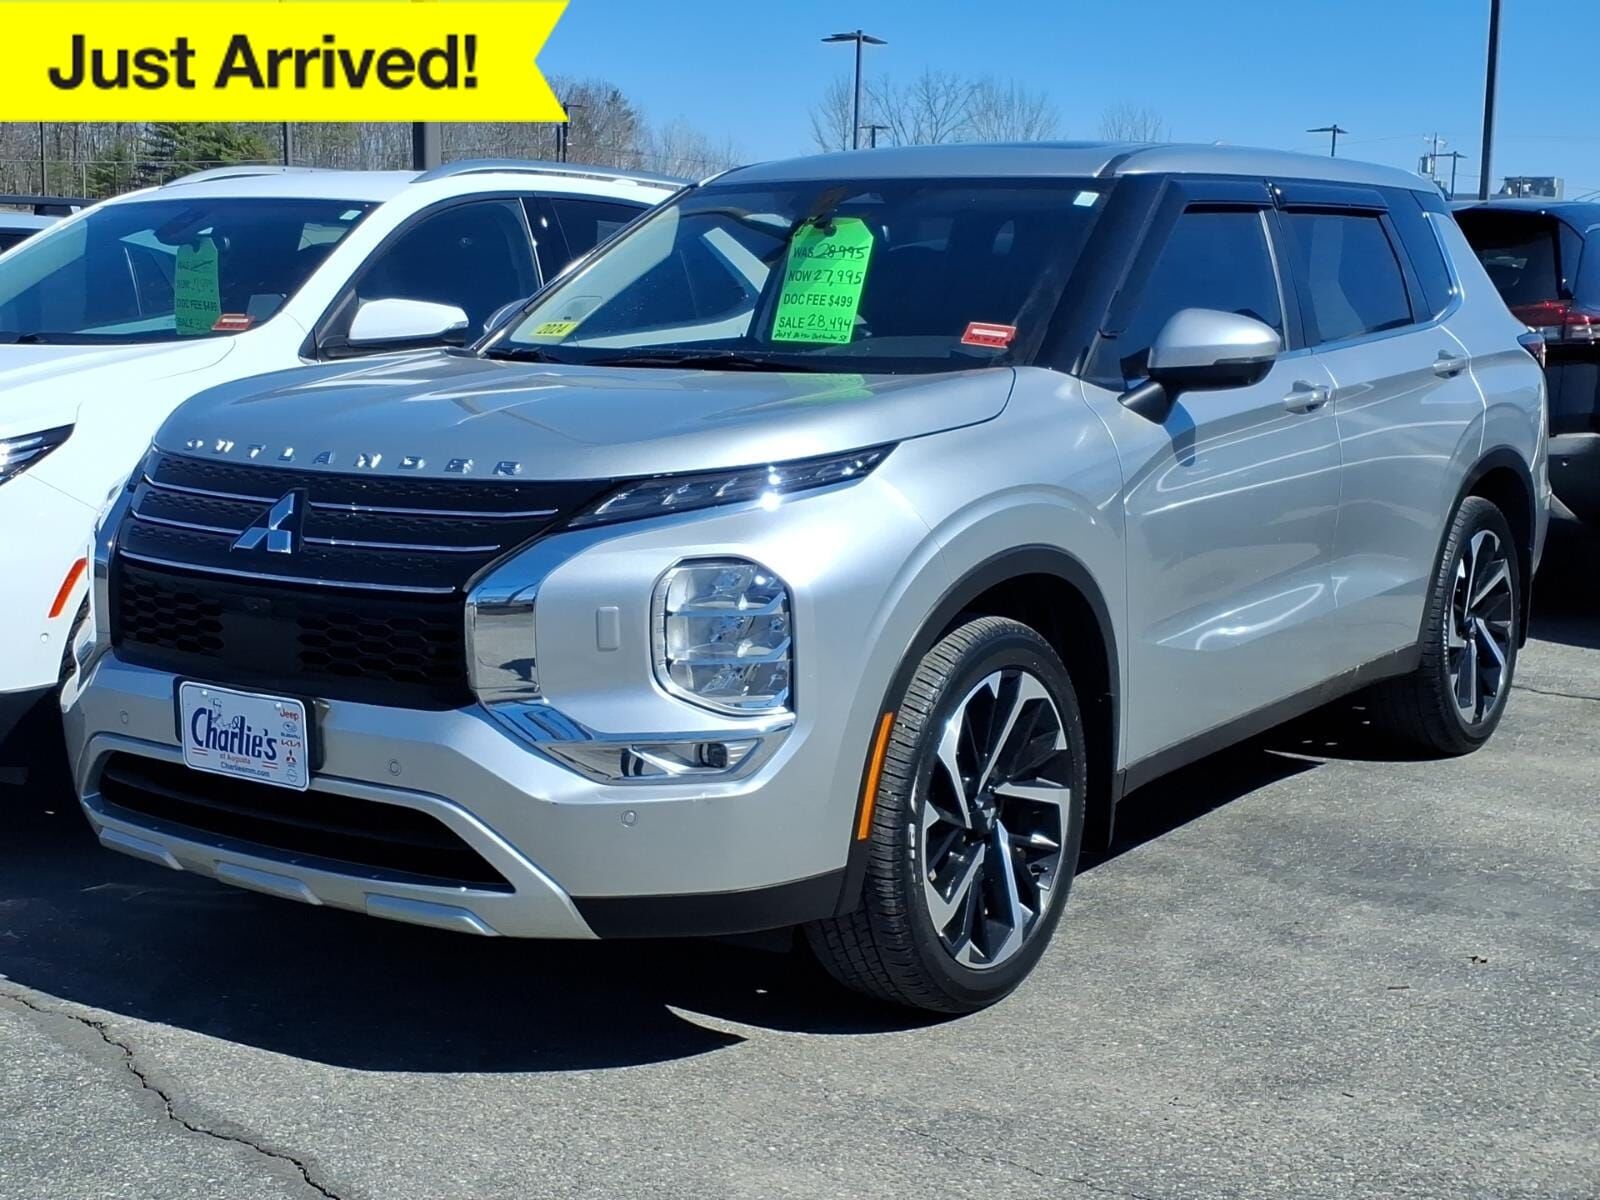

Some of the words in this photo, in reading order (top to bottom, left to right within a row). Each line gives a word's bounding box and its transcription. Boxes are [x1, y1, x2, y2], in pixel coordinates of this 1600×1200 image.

[793, 246, 814, 259] WAS
[789, 270, 812, 282] NOW
[813, 269, 863, 286] 27,995
[783, 293, 805, 305] DOC
[805, 294, 827, 306] FEE
[828, 295, 853, 307] $499
[536, 323, 570, 334] 2024
[778, 316, 805, 329] SALE
[807, 313, 852, 331] 28,494
[184, 439, 523, 476] OUTLANDER
[280, 708, 300, 721] Jeep
[191, 707, 278, 761] Charlie's
